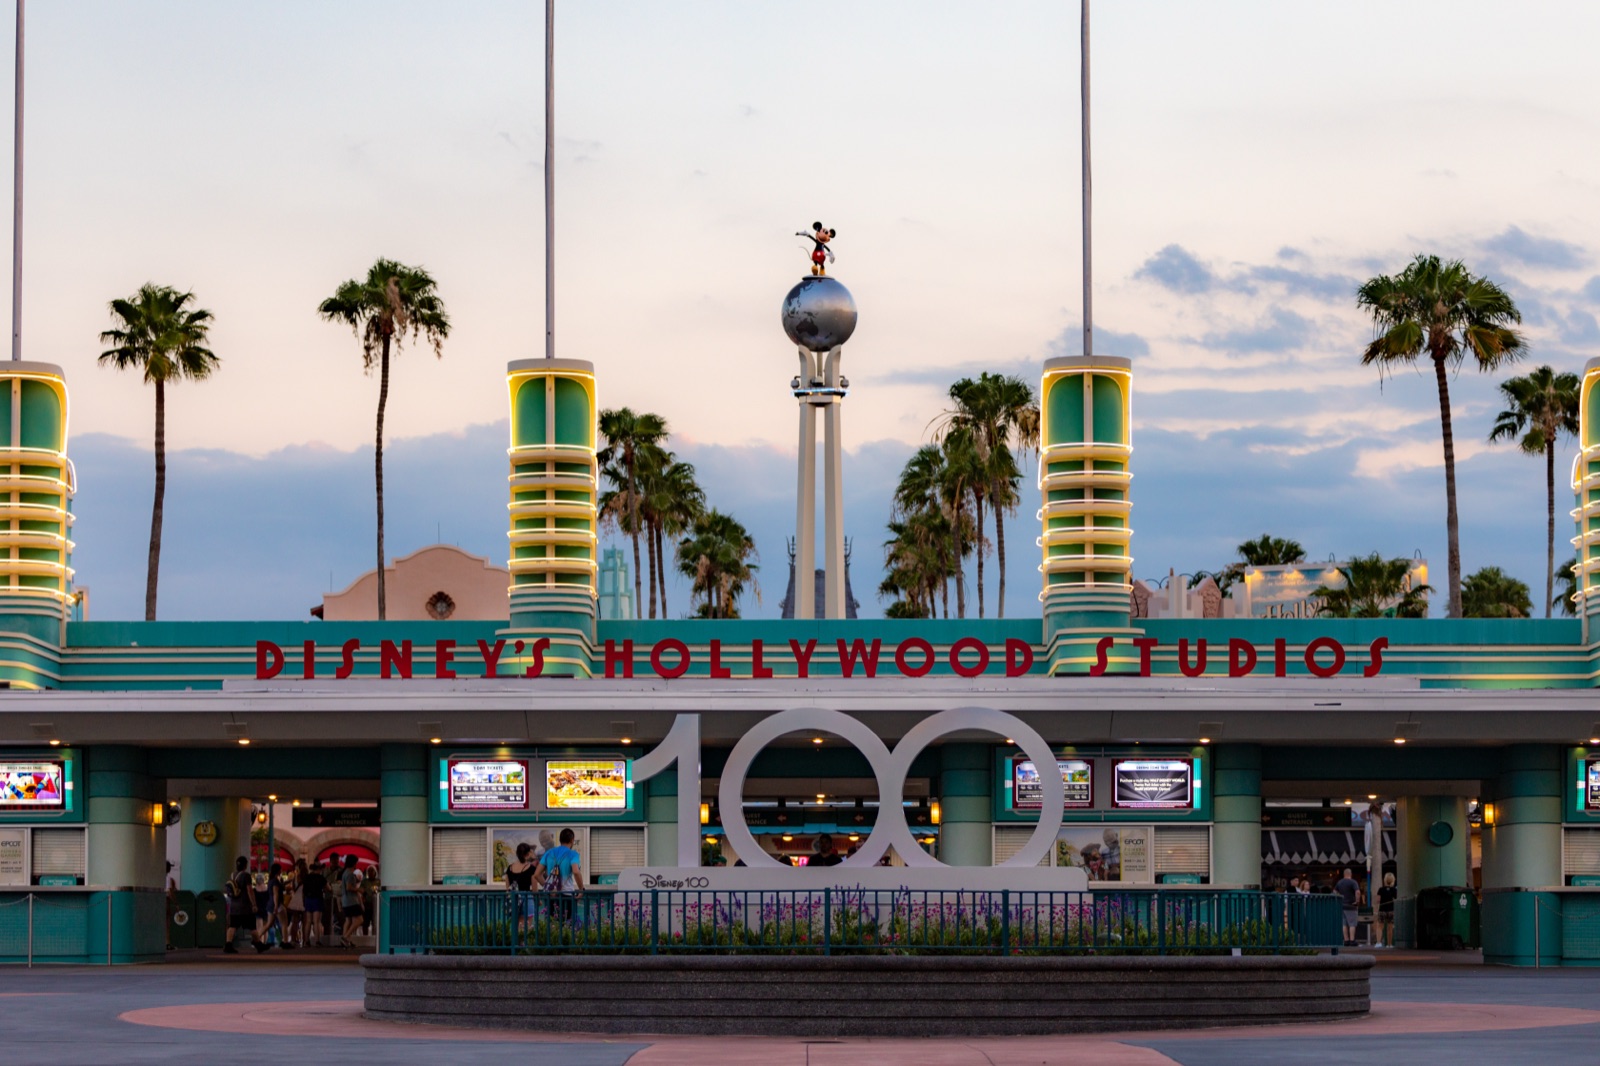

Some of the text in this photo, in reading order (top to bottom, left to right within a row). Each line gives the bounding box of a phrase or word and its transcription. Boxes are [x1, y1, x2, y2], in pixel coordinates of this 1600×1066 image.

[256, 636, 1389, 679] DISNEY'S HOLLYWOOD STUDIOS
[632, 706, 1065, 868] 100
[639, 873, 709, 890] Disney 100
